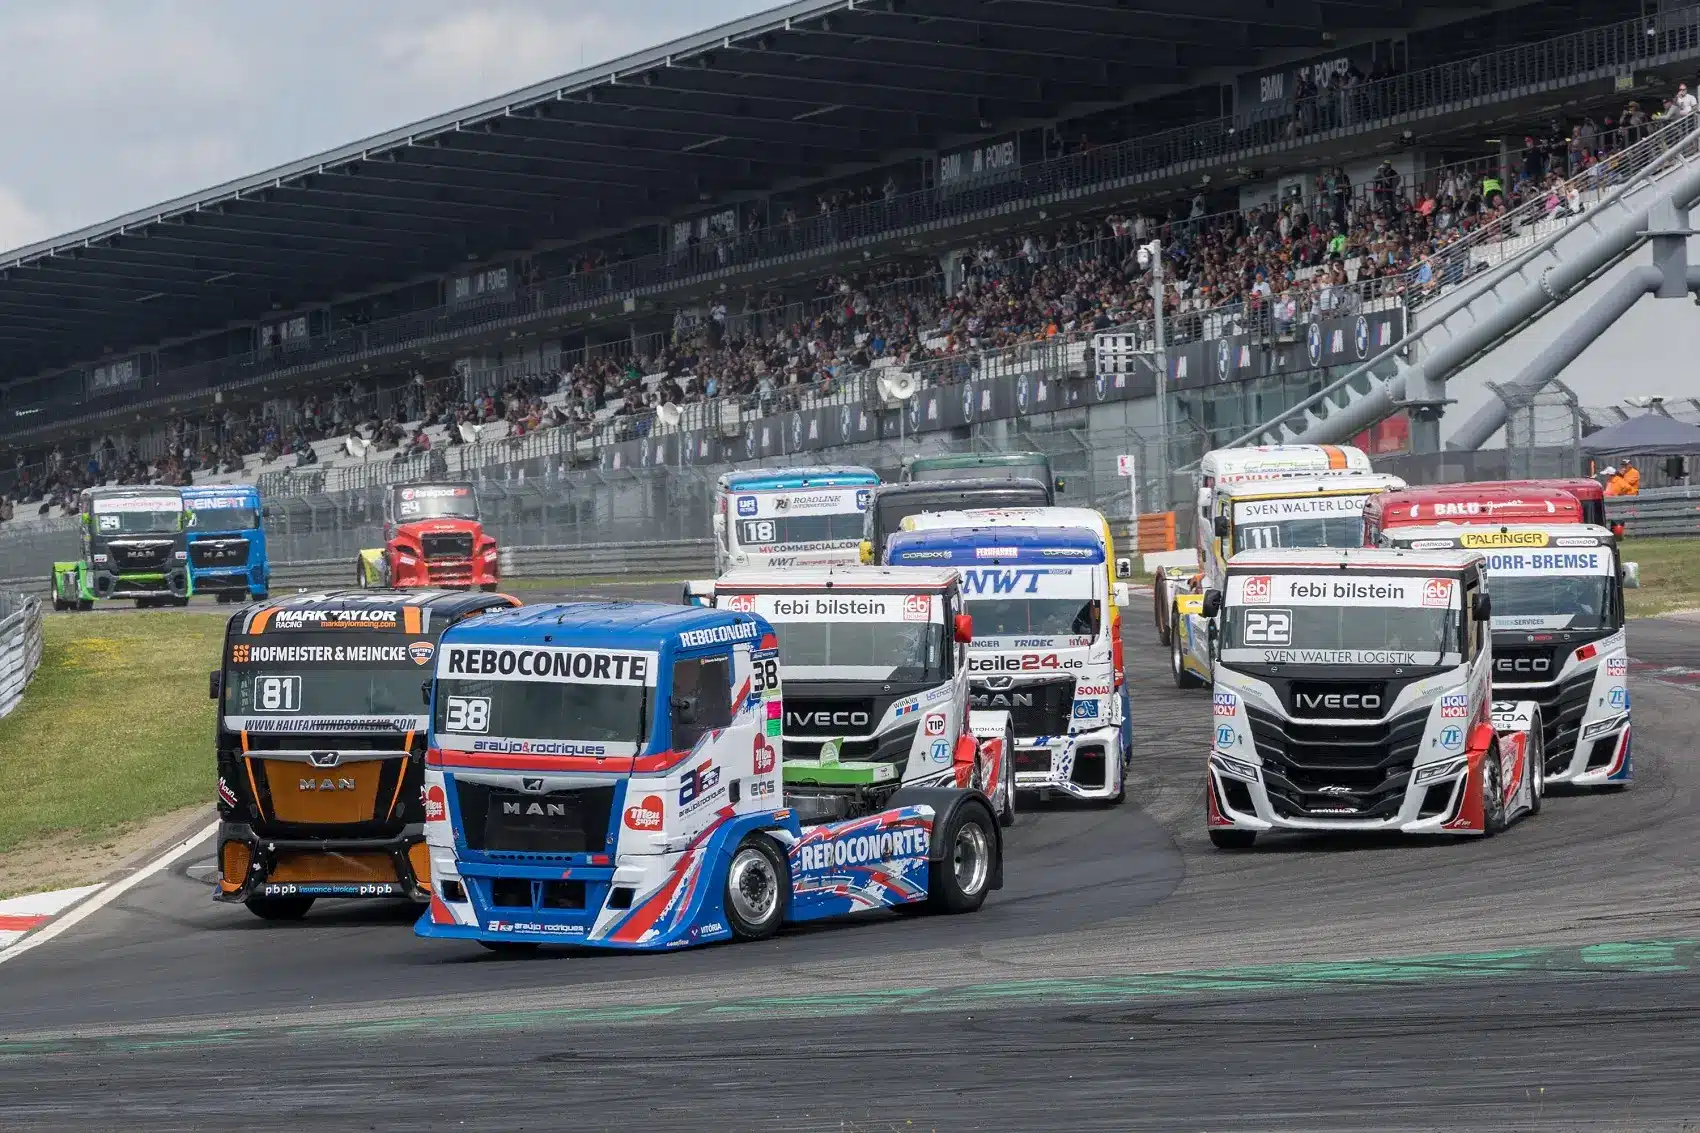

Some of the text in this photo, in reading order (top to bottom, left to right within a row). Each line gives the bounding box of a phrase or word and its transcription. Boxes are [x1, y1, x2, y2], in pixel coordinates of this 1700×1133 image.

[1260, 73, 1283, 102] BMW
[1246, 503, 1278, 516] SVEN
[1281, 501, 1333, 513] WALTER
[748, 522, 772, 541] 18
[1251, 528, 1272, 549] 11
[1467, 533, 1543, 545] PALFINGER
[127, 550, 155, 558] MAN
[768, 556, 796, 567] NWT
[963, 569, 1050, 594] NWT
[1244, 576, 1270, 595] febi
[1290, 582, 1404, 599] febi bilstein
[774, 600, 886, 615] febi bilstein
[276, 610, 397, 621] MARK TAYLOR
[321, 620, 396, 629] marktaylorracing.com
[1246, 614, 1289, 641] 22
[968, 640, 999, 648] INGER
[1014, 639, 1054, 647] TRIDEC
[251, 646, 333, 662] HOFMEISTER
[334, 647, 345, 661] &
[347, 646, 406, 661] MEINCKE
[1264, 651, 1416, 664] SVEN WALTER LOGISTIK
[449, 649, 647, 680] REBOCONORTE
[753, 659, 778, 691] 38
[263, 678, 292, 709] 81
[969, 694, 1032, 706] MAN
[1296, 693, 1381, 709] IVECO
[448, 699, 488, 730] 38
[787, 712, 869, 726] IVECO
[928, 721, 943, 731] TIP
[1218, 729, 1233, 743] ZF
[1443, 730, 1462, 744] ZF
[932, 744, 949, 758] ZF
[300, 778, 355, 792] MAN
[503, 802, 565, 815] MAN
[631, 808, 660, 819] Meu
[635, 817, 660, 827] super
[802, 828, 925, 871] REBOCONORTE
